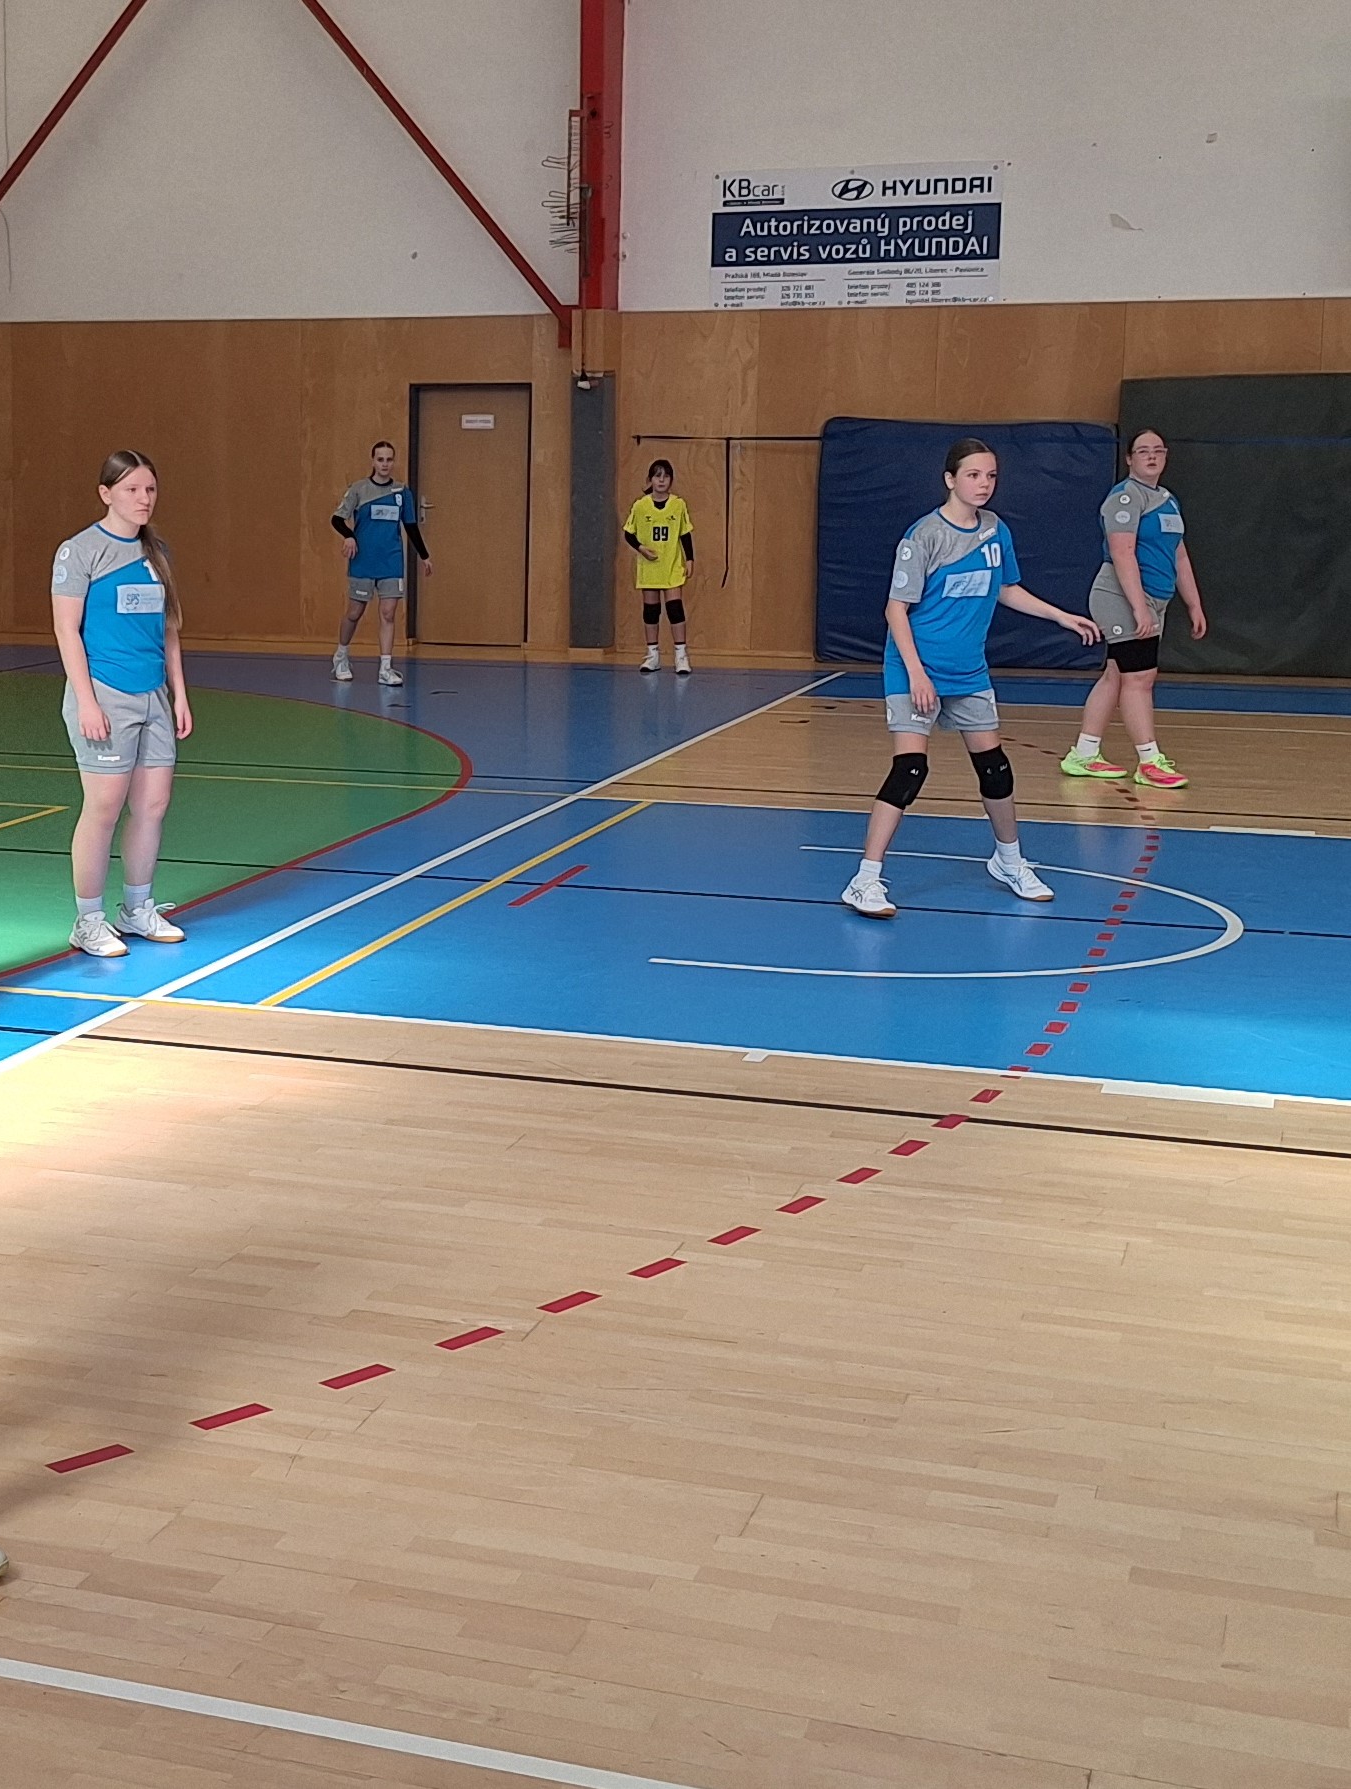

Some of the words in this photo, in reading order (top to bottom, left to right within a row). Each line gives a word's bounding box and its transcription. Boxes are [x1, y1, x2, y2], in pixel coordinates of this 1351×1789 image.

[882, 176, 992, 197] HYUNDAI
[739, 213, 889, 237] Autorizovaný
[898, 210, 973, 236] prodej
[724, 248, 736, 261] a
[745, 242, 810, 261] servis
[818, 238, 870, 259] vozů
[880, 236, 988, 258] HYUNDAI
[653, 526, 669, 541] 89
[980, 542, 1001, 568] 10
